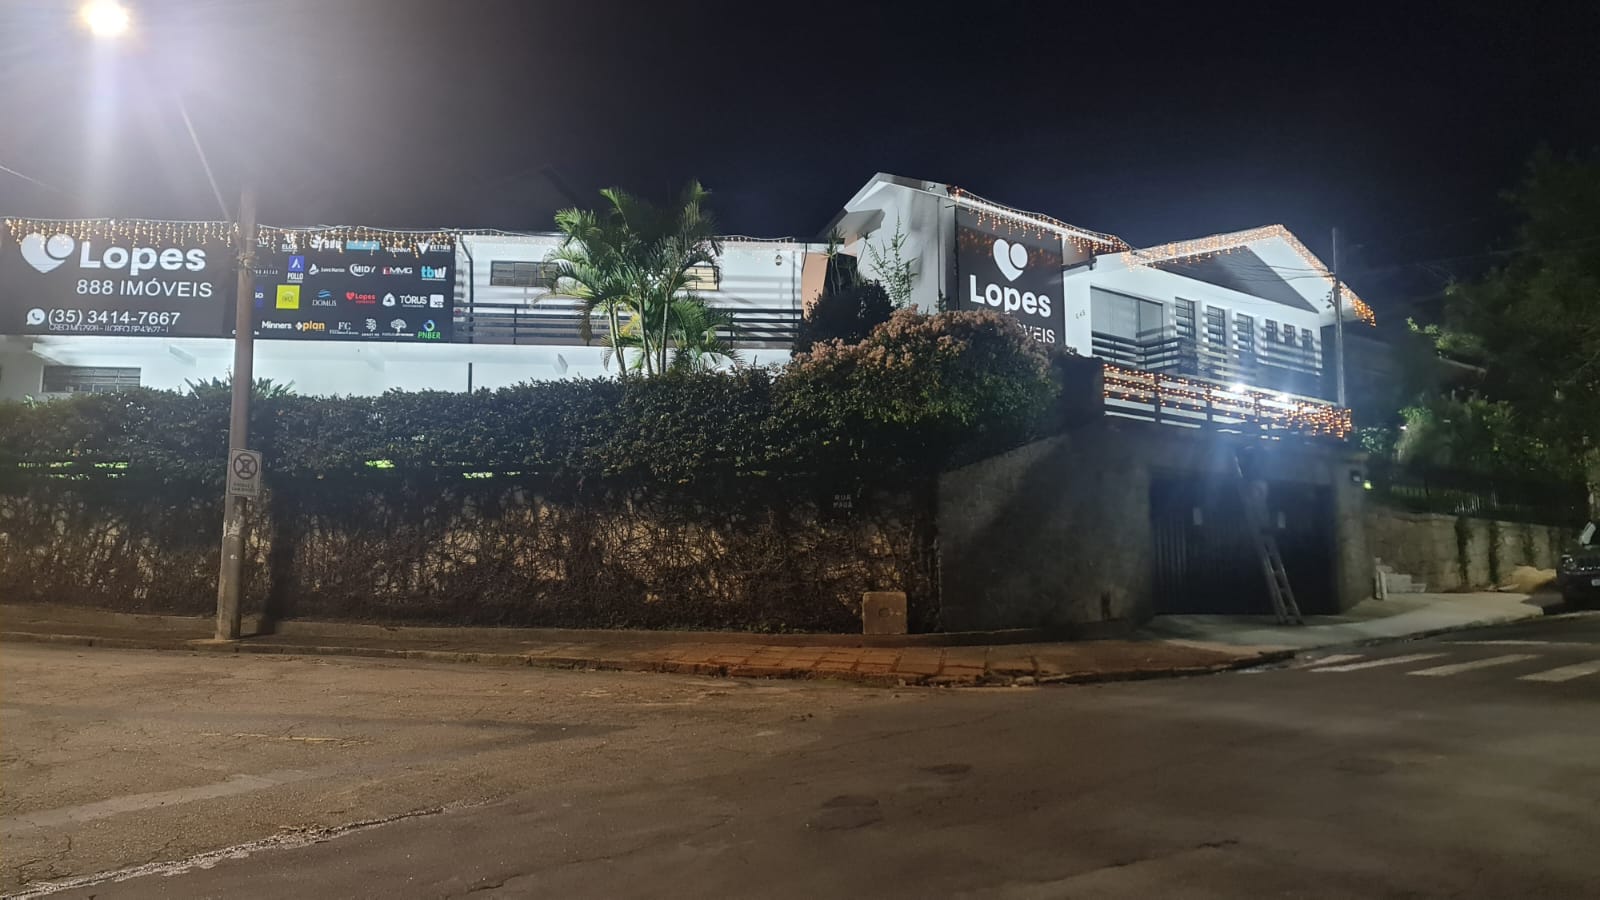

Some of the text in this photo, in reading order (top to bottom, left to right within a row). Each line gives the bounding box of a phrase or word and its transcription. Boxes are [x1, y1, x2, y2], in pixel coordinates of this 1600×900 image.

[80, 241, 207, 276] Lopes
[287, 272, 304, 280] POLLO
[76, 278, 213, 298] 888 IMÓVEIS
[312, 299, 337, 307] DOMUS
[399, 294, 428, 305] TÓRUS
[969, 274, 1052, 318] Lopes
[48, 309, 181, 327] (35) 3414-7667
[261, 320, 292, 329] Minners
